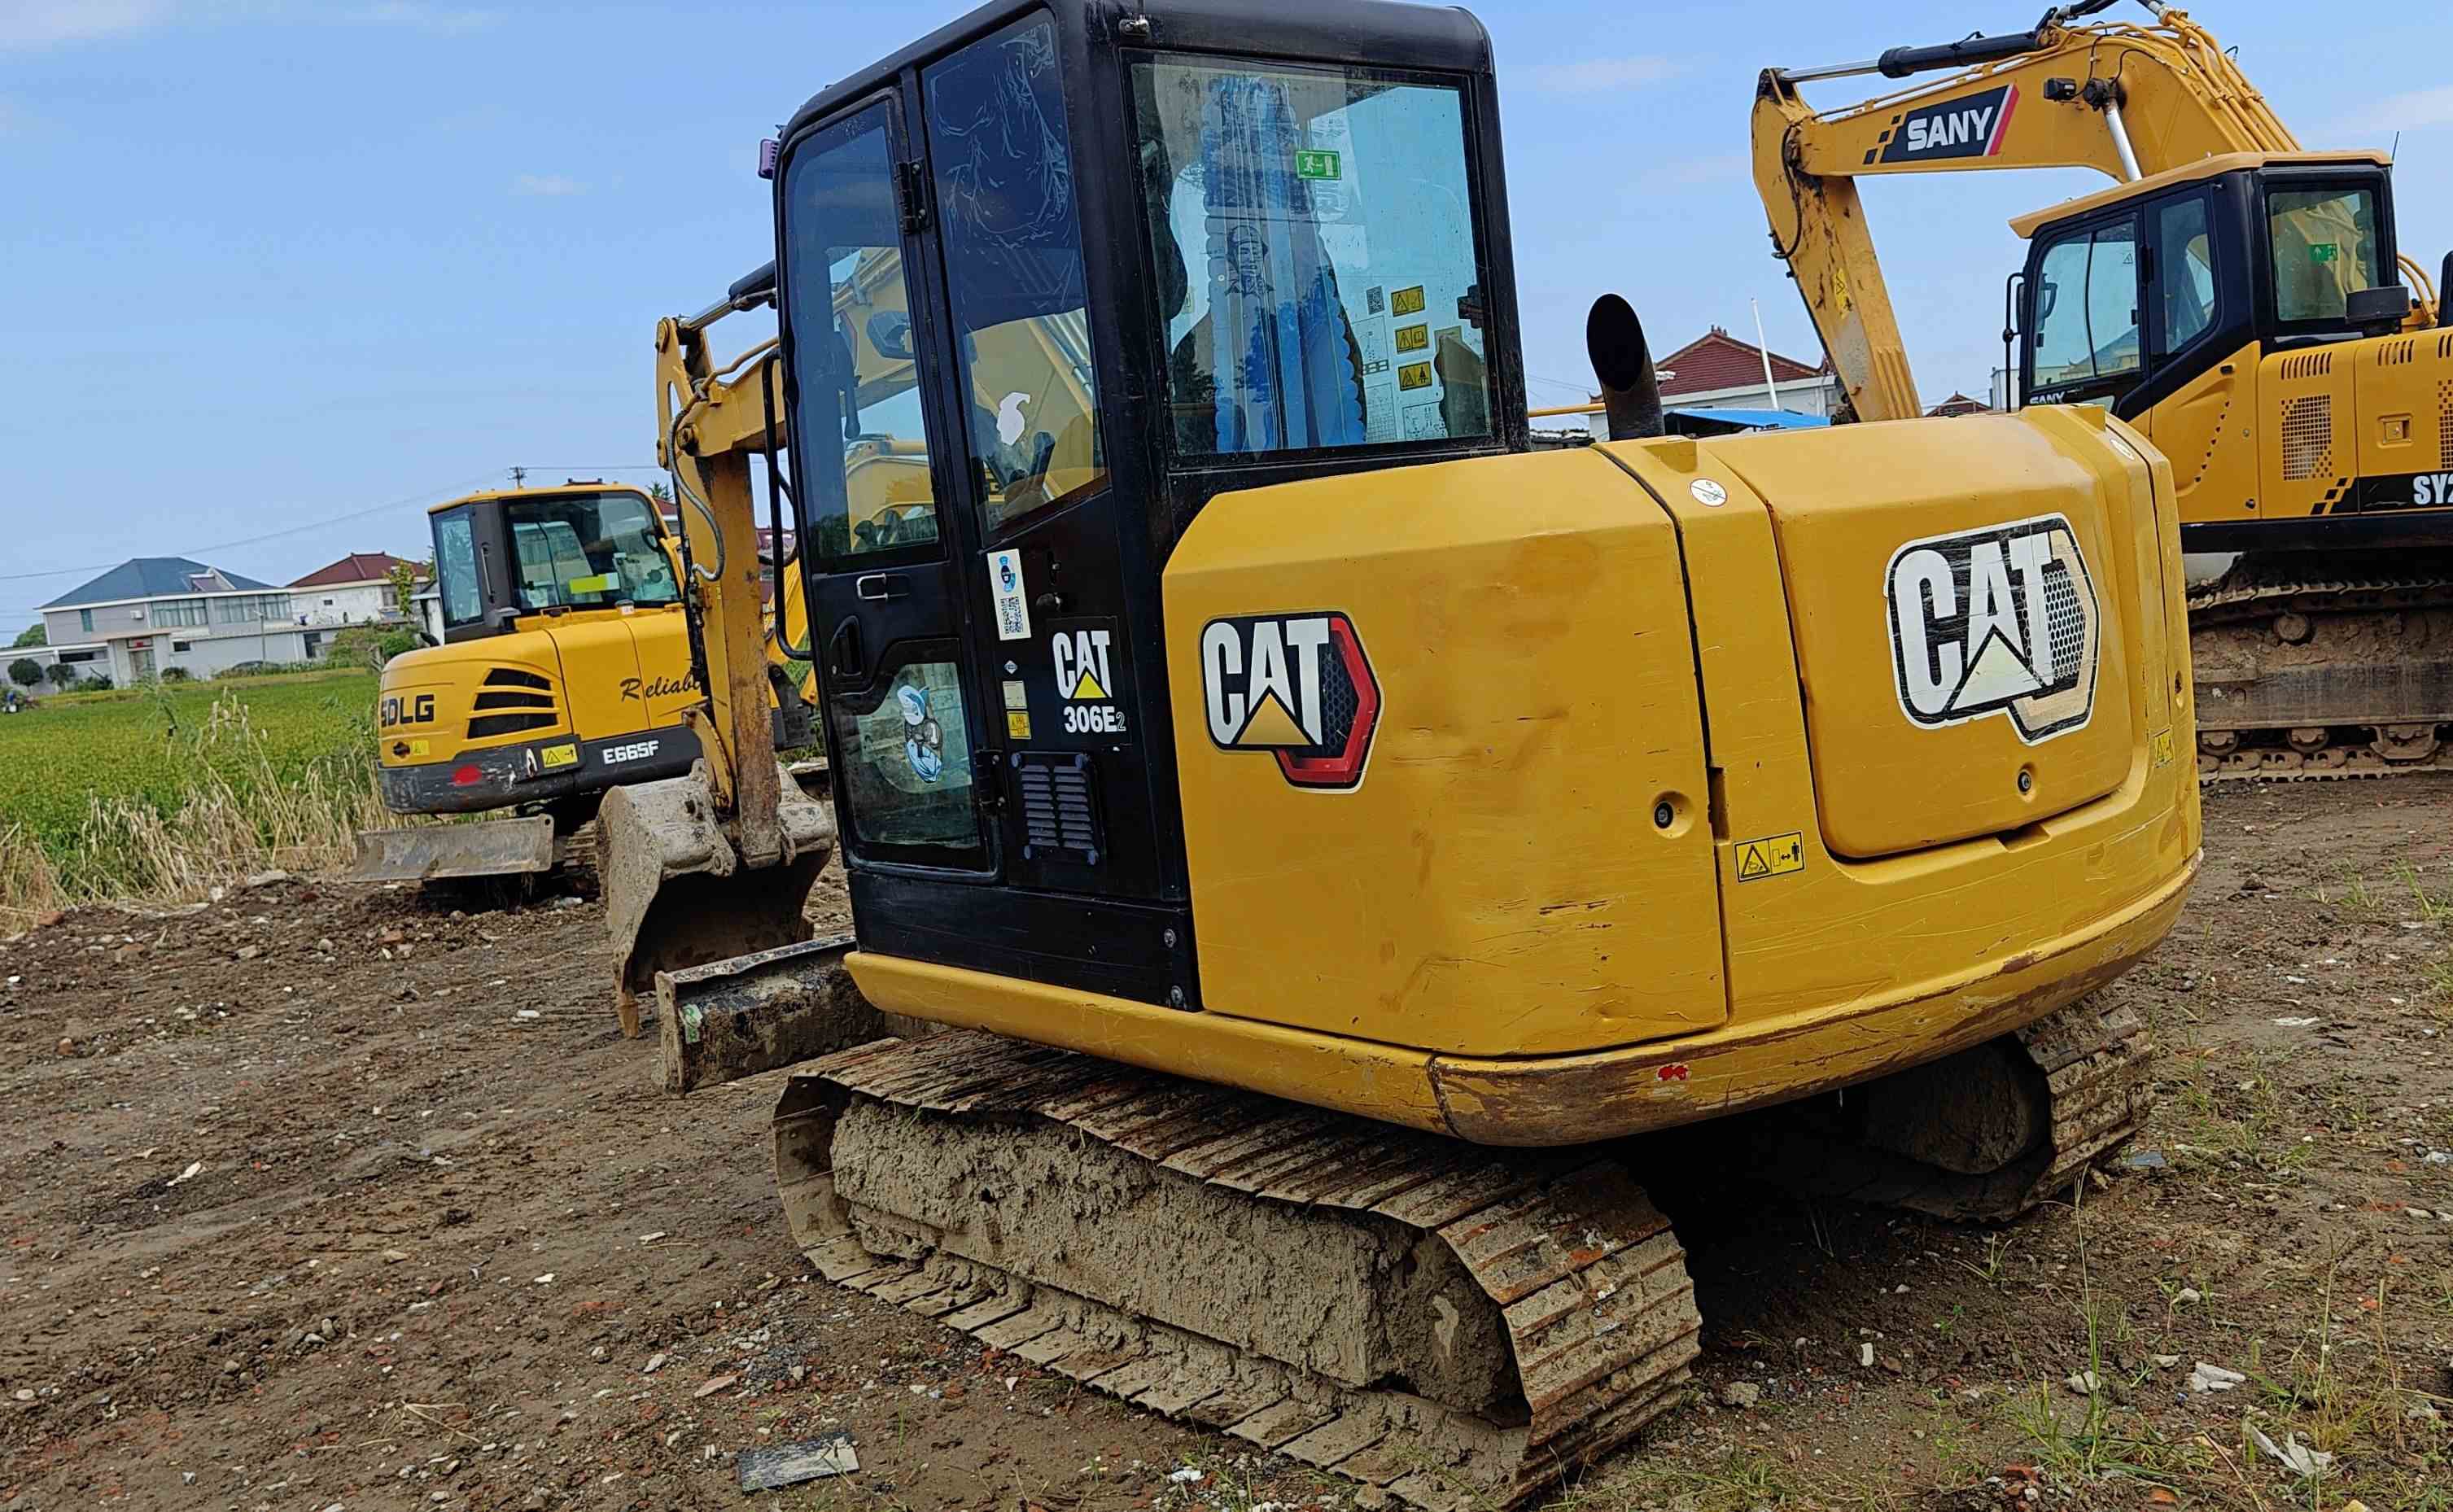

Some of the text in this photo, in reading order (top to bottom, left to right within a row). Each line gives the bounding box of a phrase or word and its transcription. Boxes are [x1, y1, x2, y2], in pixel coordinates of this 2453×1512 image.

[1908, 107, 1993, 151] SANY
[1894, 531, 2054, 715] CAT
[1052, 630, 1113, 700] CAT
[1203, 617, 1329, 745] CAT
[1063, 705, 1127, 733] 306E2
[601, 739, 660, 765] E665F
